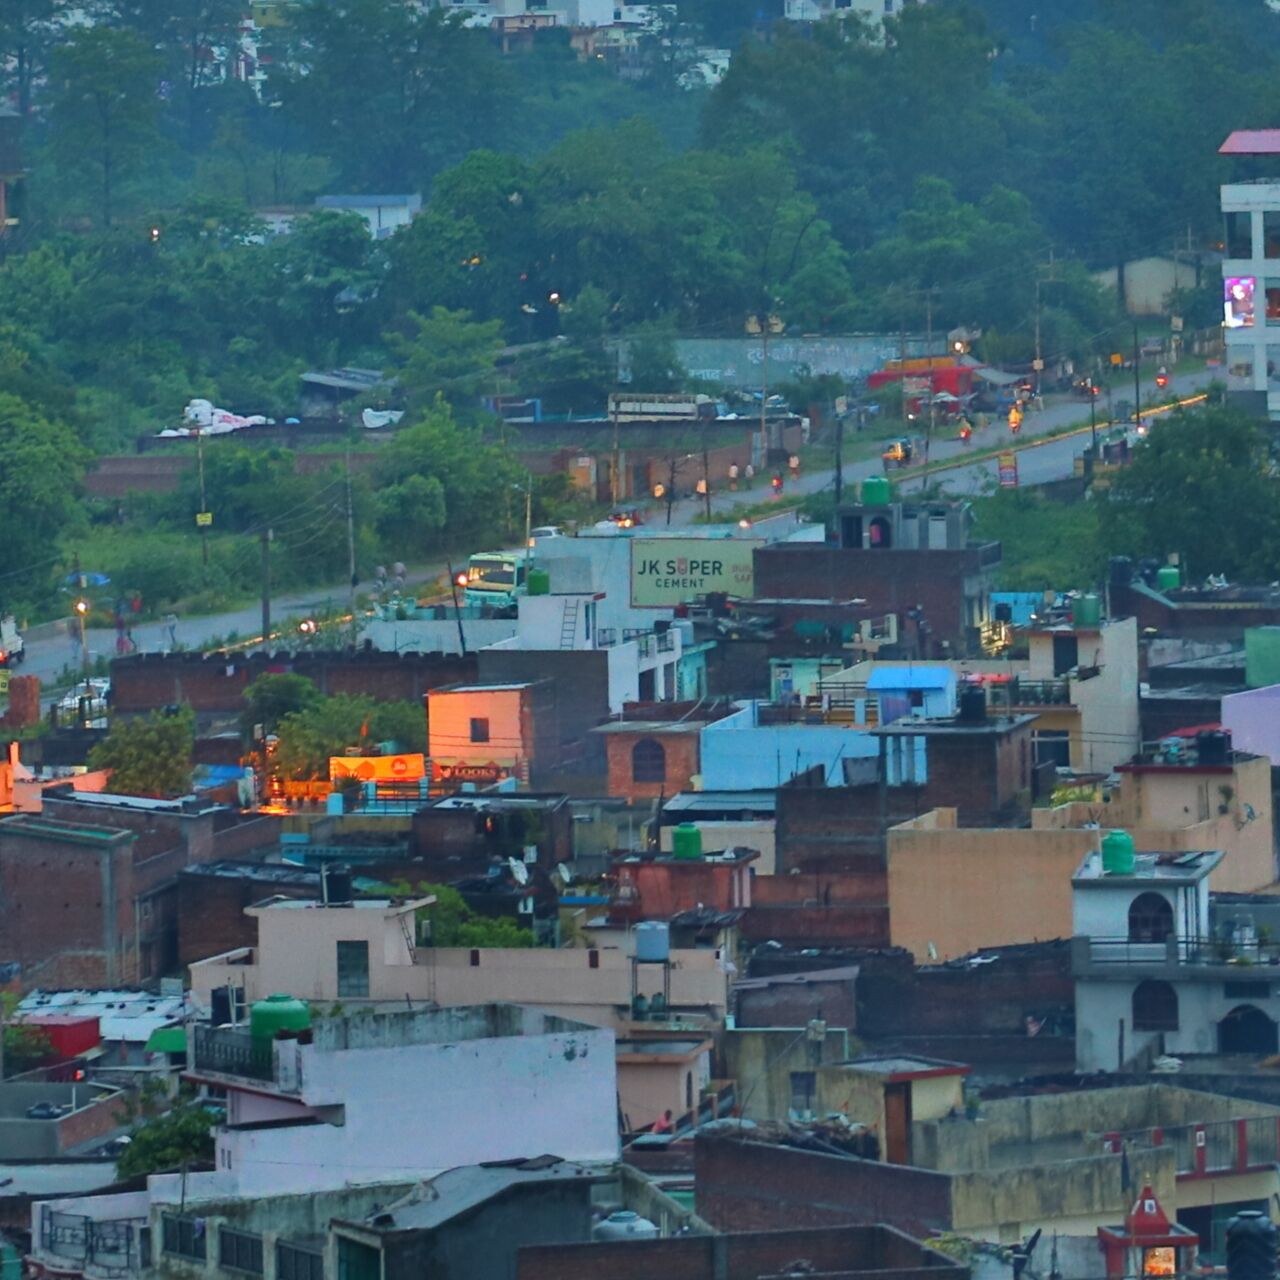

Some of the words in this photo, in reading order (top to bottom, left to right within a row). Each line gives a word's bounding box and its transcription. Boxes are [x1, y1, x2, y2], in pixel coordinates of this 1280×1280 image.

[637, 559, 660, 575] JK
[666, 557, 723, 576] SUPER
[655, 578, 705, 588] CEMENT
[455, 768, 497, 777] LOOKS
